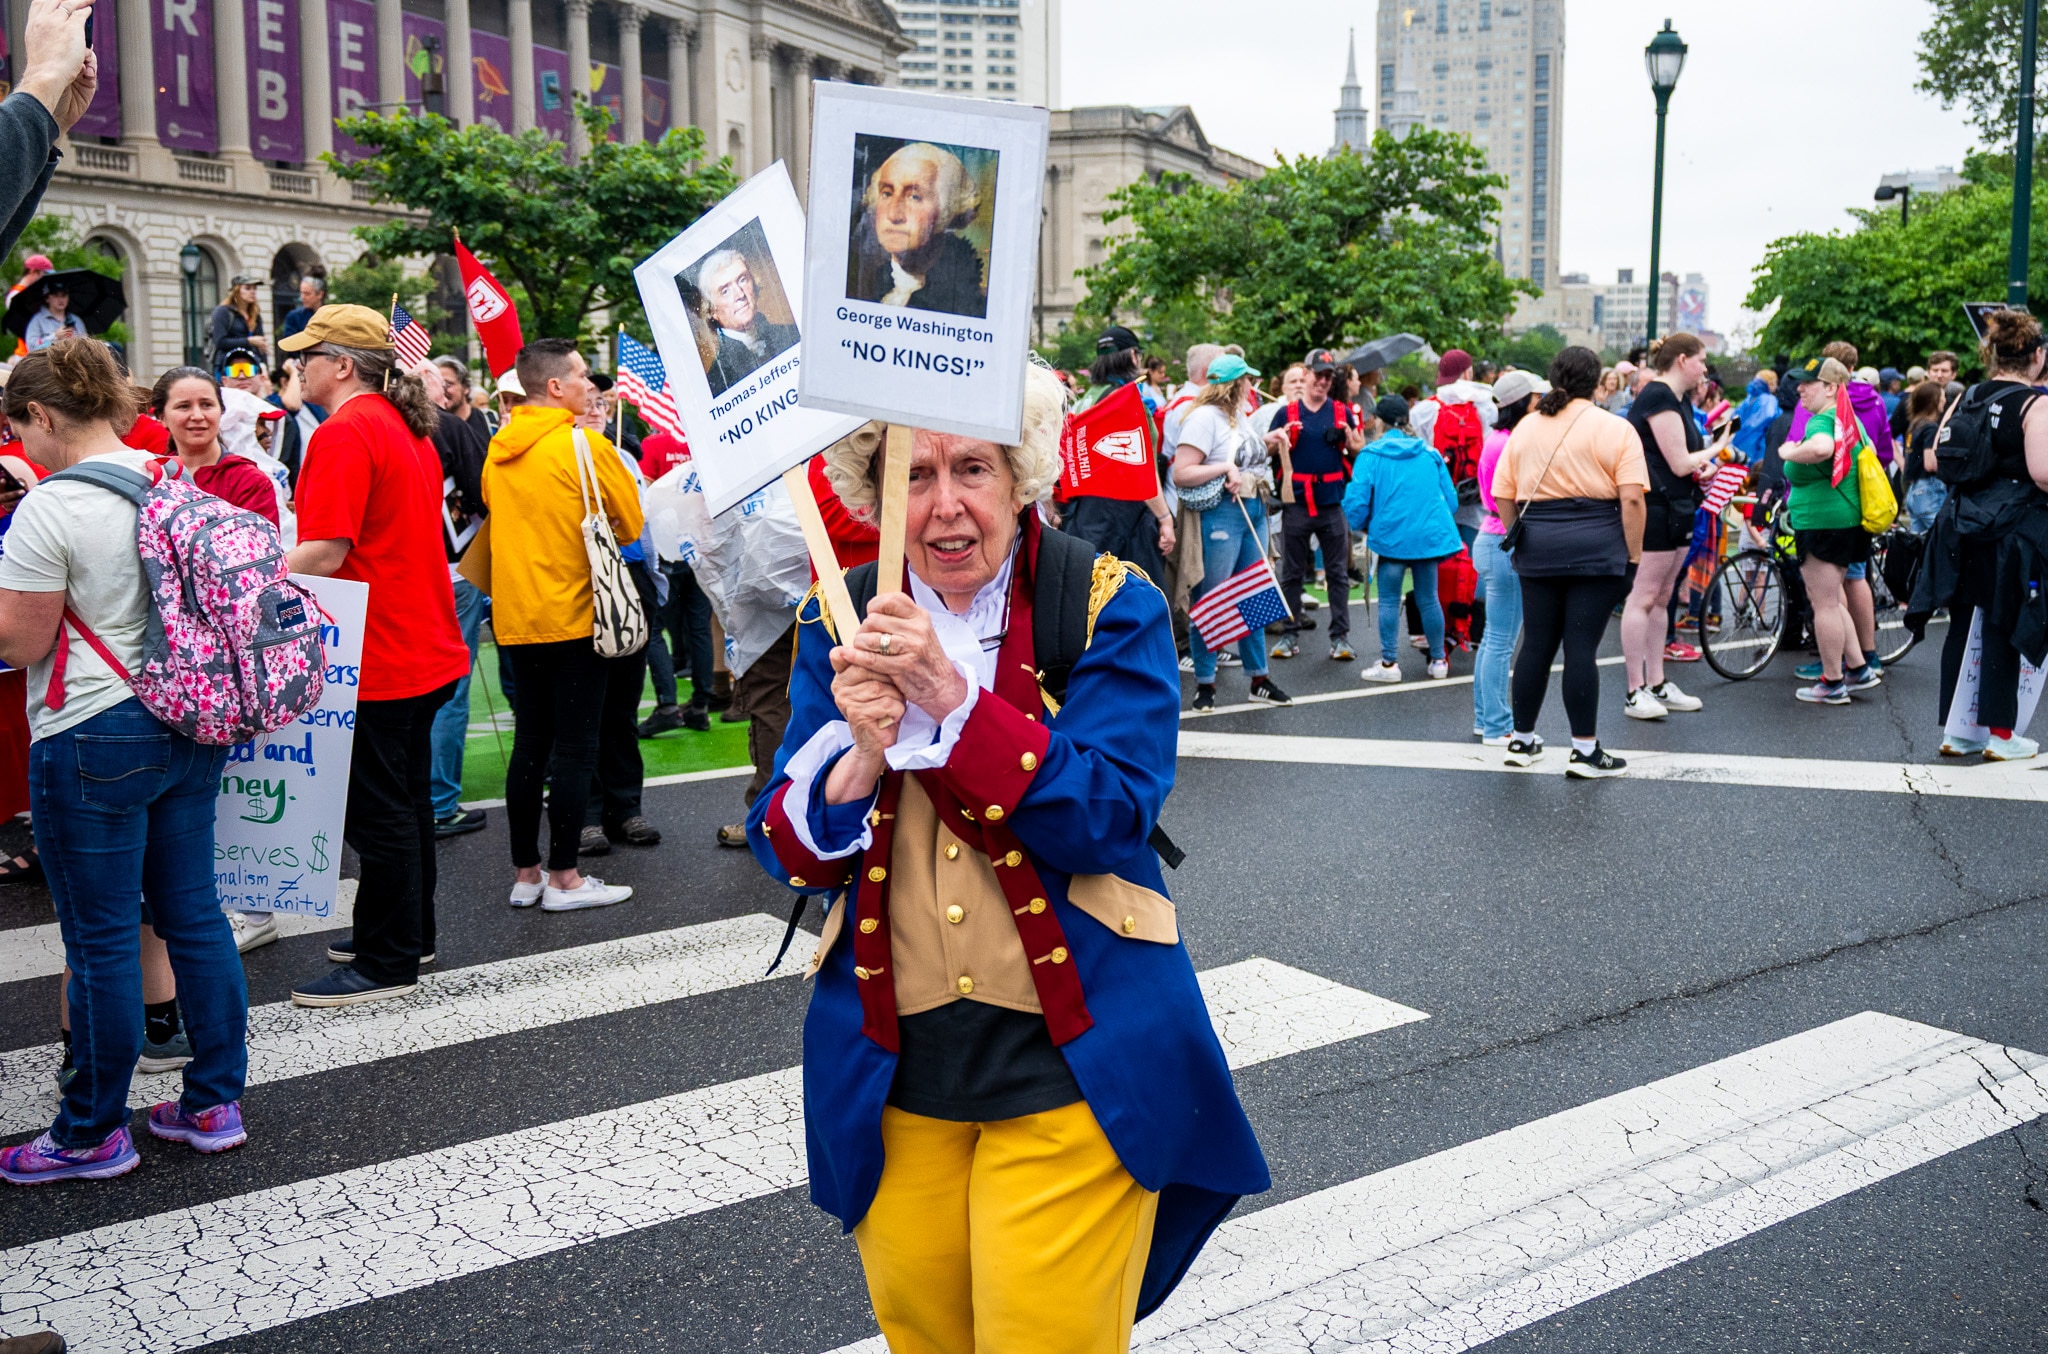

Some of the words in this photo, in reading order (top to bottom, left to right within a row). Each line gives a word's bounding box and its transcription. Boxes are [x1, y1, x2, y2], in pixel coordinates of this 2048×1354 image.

[836, 306, 892, 330] George
[896, 316, 994, 343] Washington
[841, 339, 886, 363] “NO
[893, 347, 985, 377] KINGS!”
[709, 385, 757, 421] Thomas
[719, 418, 753, 445] “NO
[1076, 425, 1092, 480] PHILADELPHIA
[742, 499, 766, 516] UFT
[264, 731, 314, 766] and
